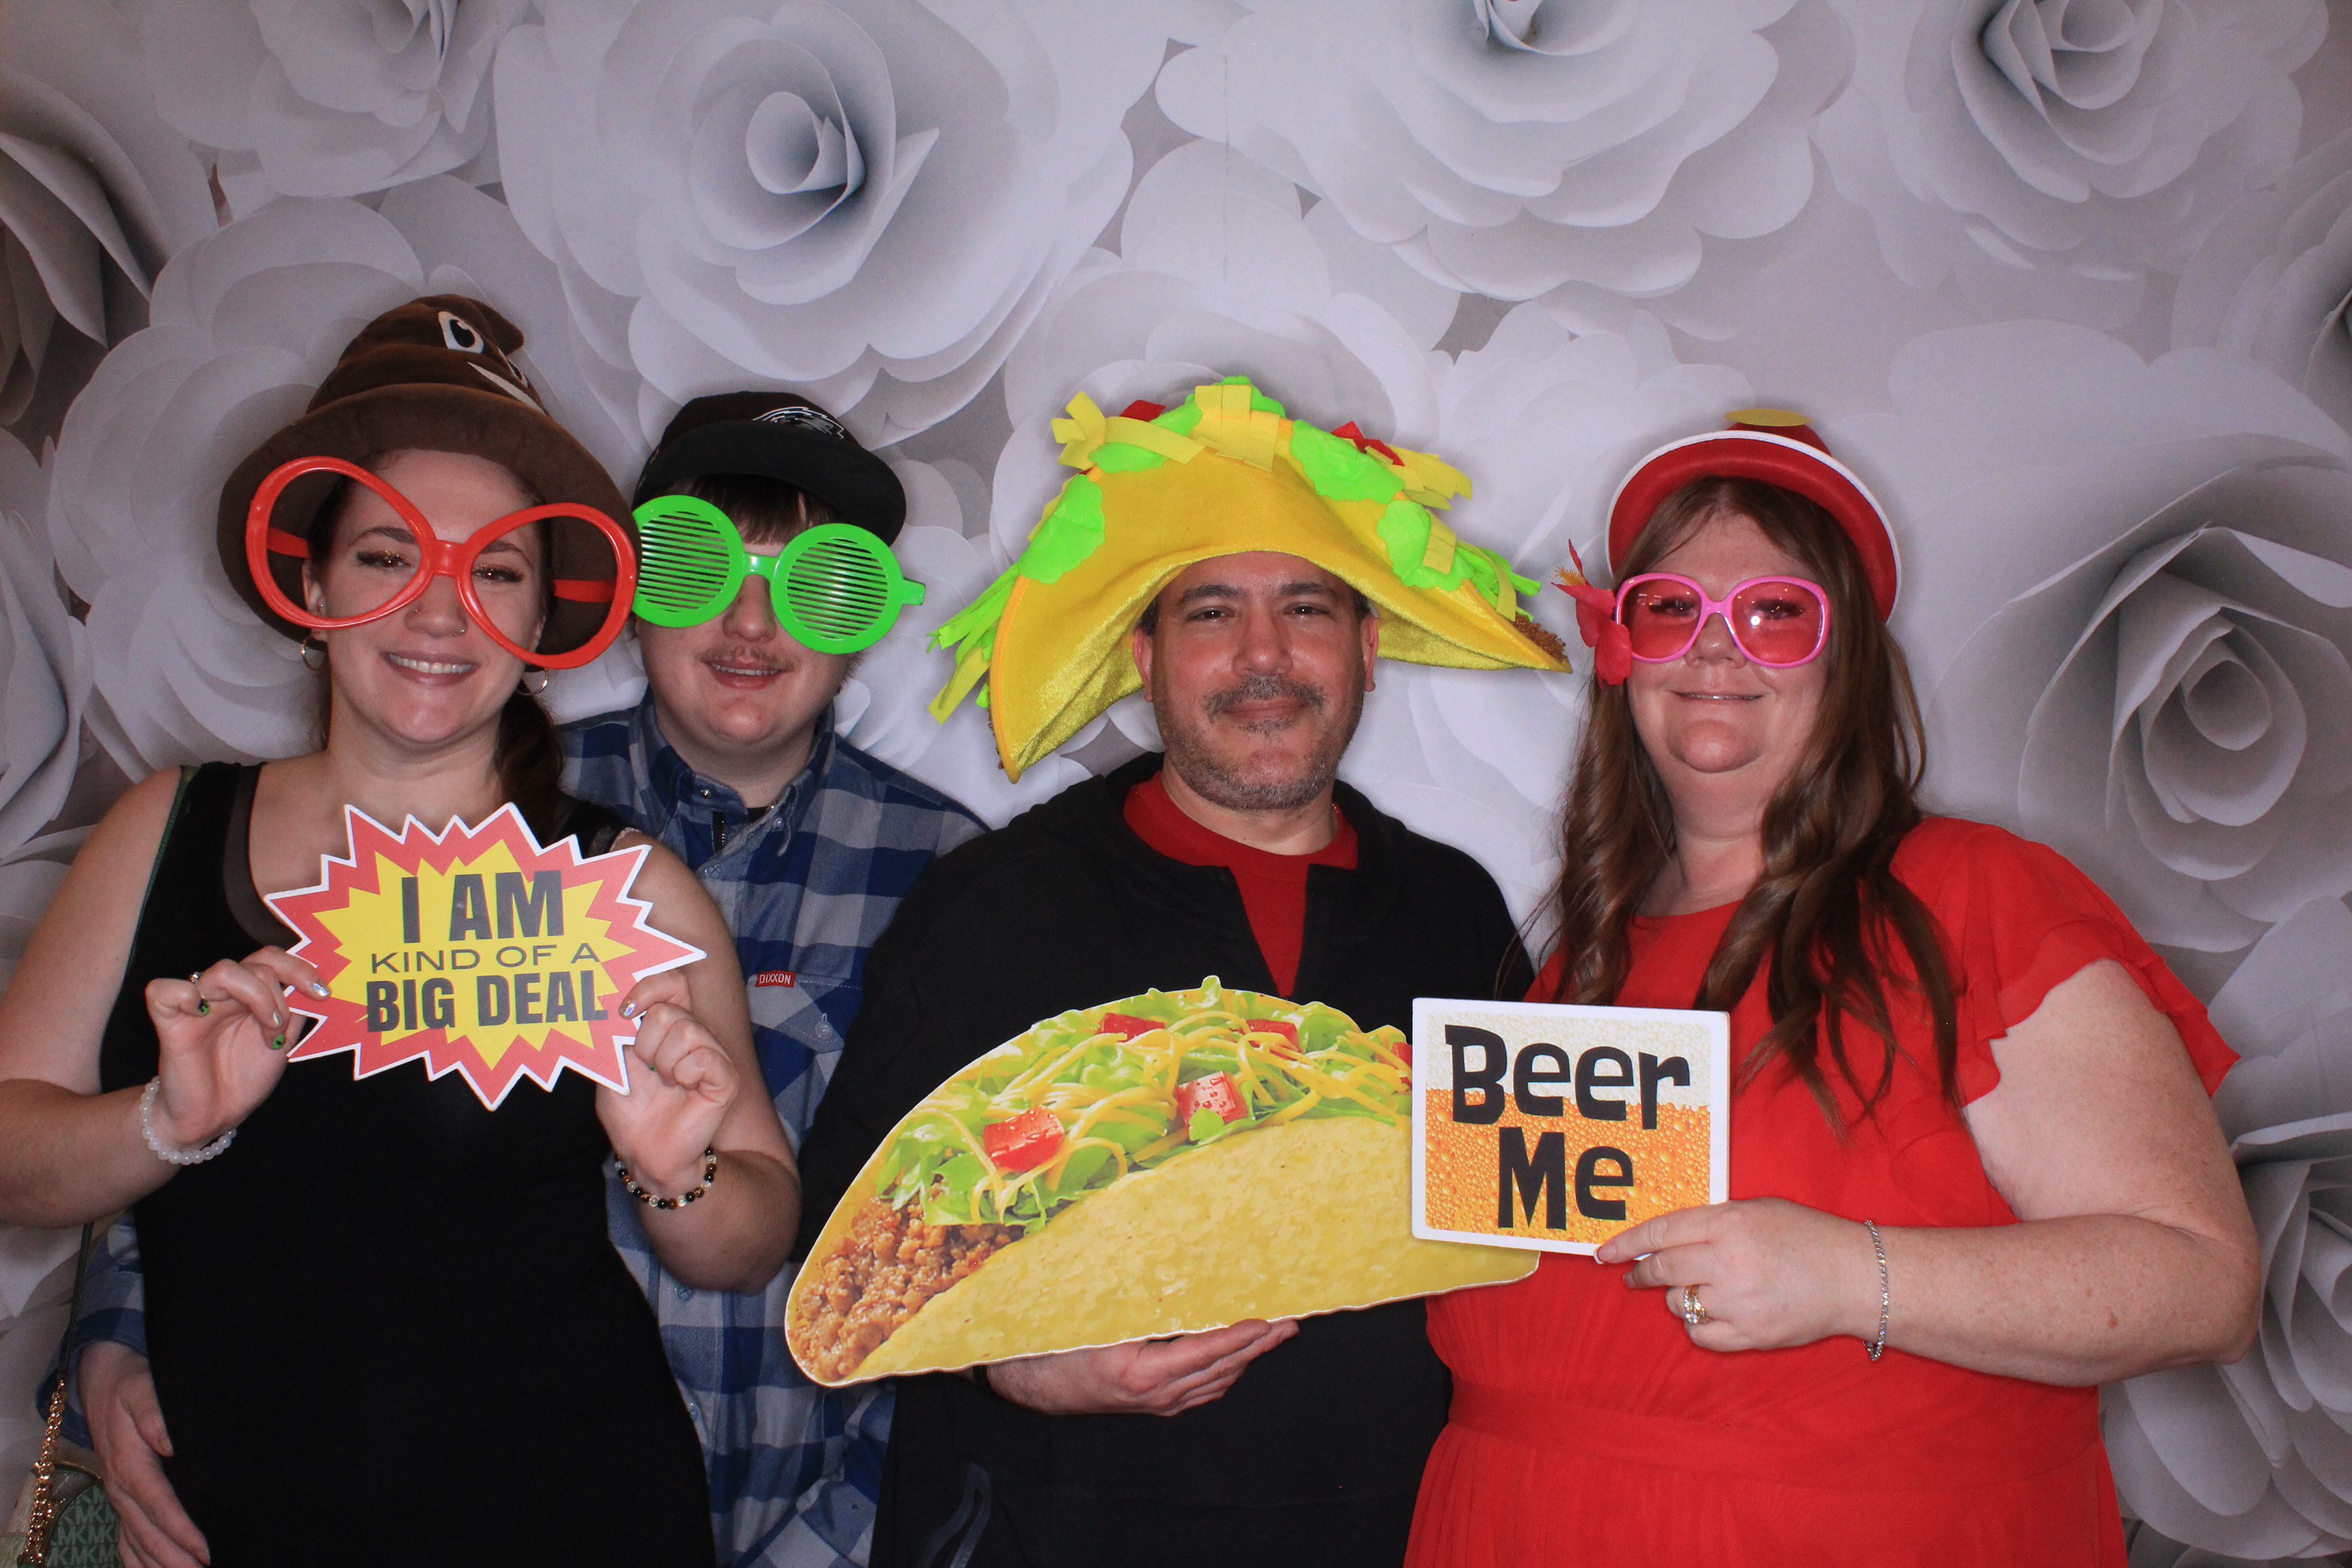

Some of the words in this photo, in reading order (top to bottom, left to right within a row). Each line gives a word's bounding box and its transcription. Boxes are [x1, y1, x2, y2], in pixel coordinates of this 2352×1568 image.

[402, 876, 421, 944] I
[448, 870, 565, 942] AM
[371, 949, 481, 974] KIND
[495, 944, 557, 968] OF
[570, 942, 601, 964] A
[758, 973, 791, 985] DIXXON
[366, 977, 456, 1033] BIG
[476, 969, 609, 1028] DEAL
[1444, 1024, 1691, 1131] Beer
[1497, 1126, 1635, 1231] Me
